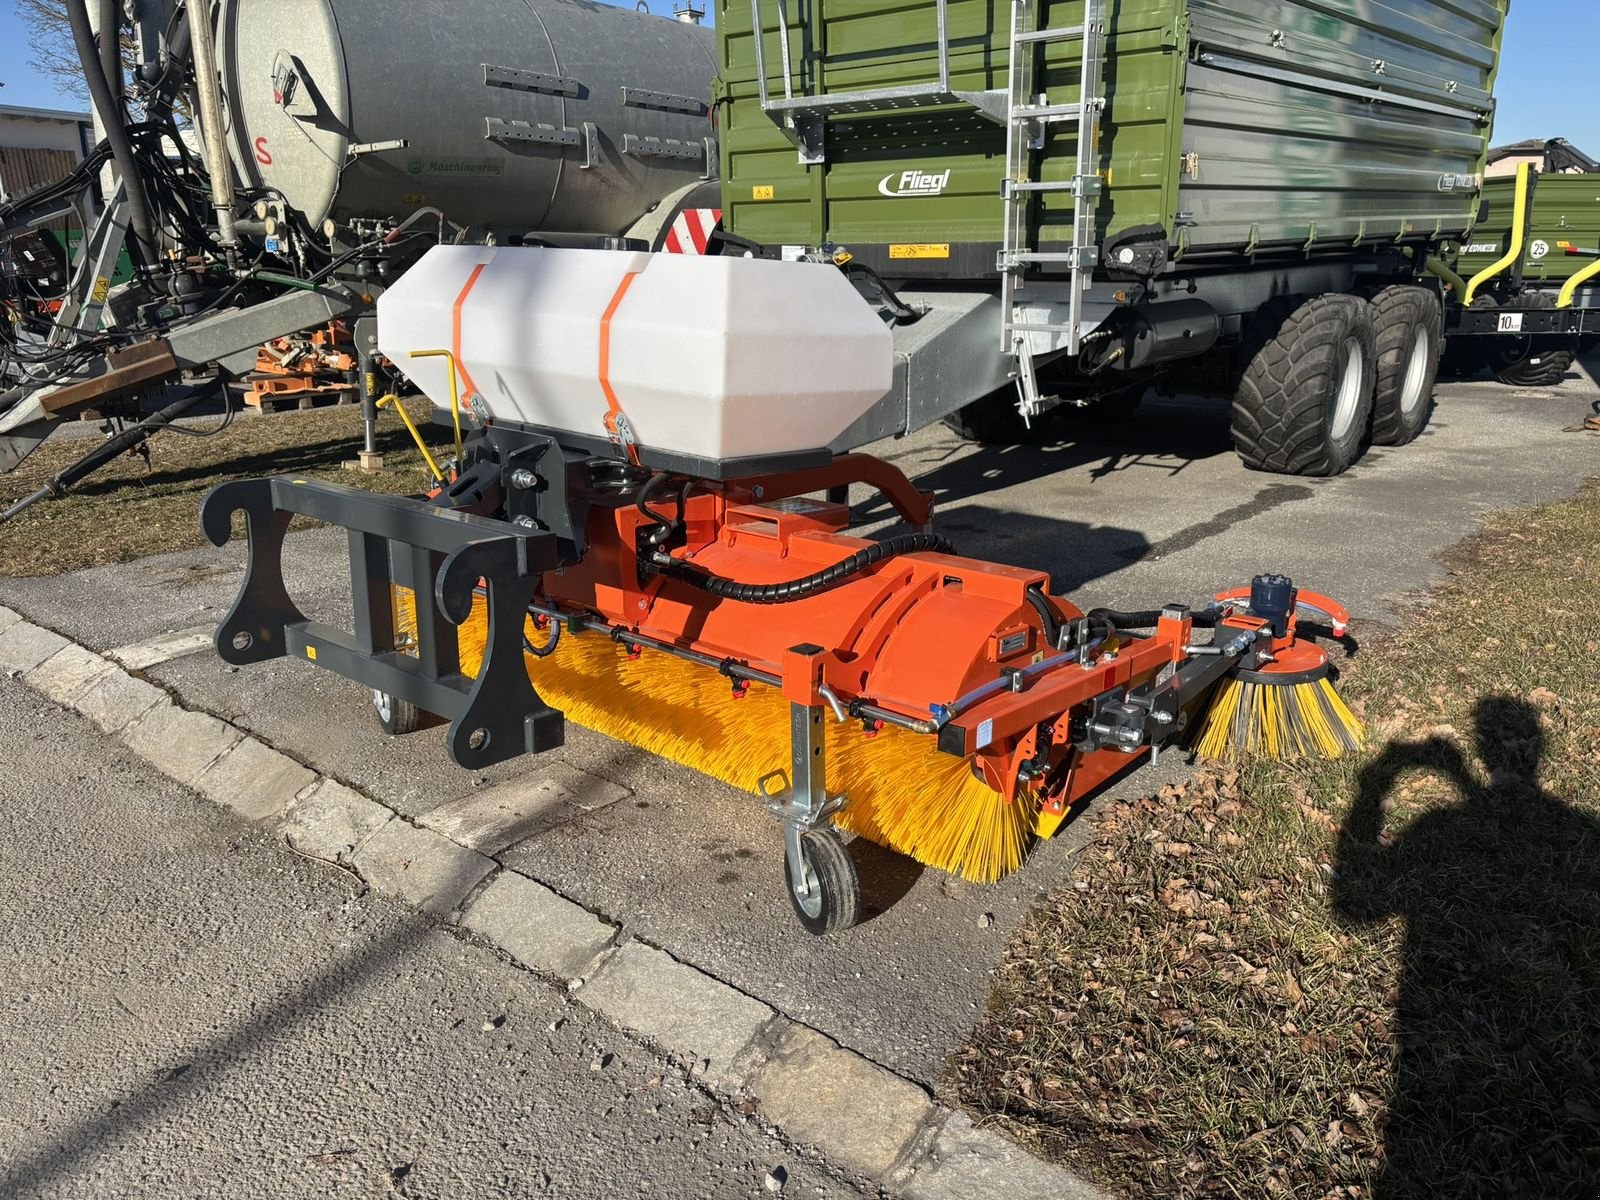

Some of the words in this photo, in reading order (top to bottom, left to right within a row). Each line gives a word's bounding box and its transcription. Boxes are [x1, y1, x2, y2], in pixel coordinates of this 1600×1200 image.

[255, 137, 272, 165] S
[429, 160, 502, 176] Maschinenring
[898, 168, 951, 193] Fliegl
[1533, 243, 1545, 256] 25
[1500, 315, 1512, 330] 10
